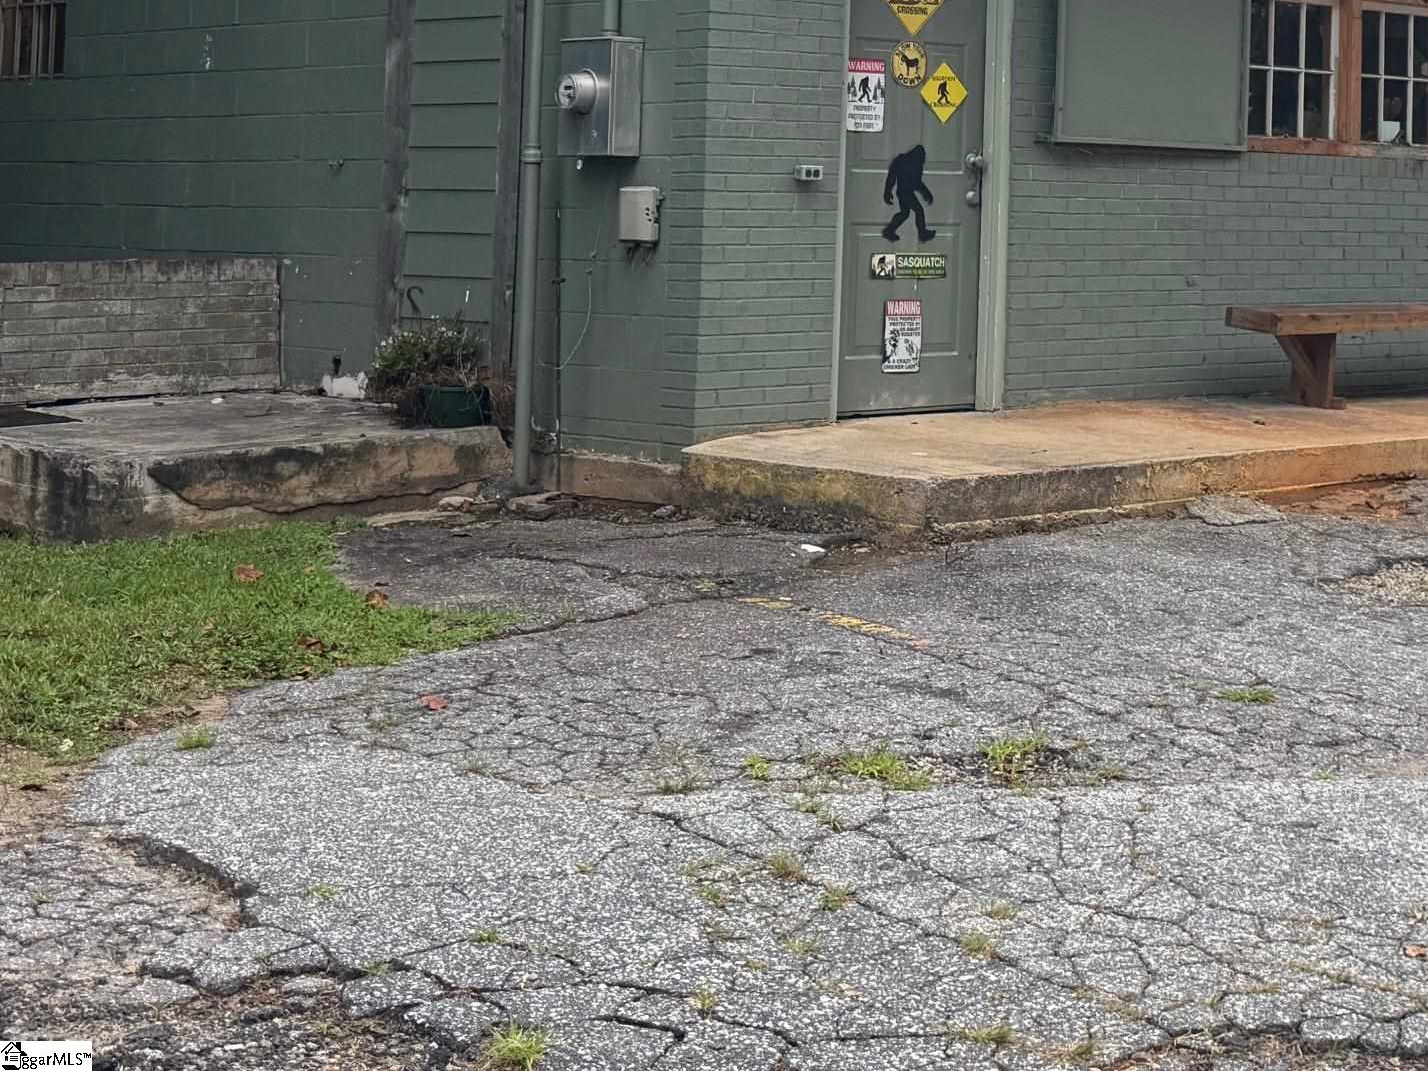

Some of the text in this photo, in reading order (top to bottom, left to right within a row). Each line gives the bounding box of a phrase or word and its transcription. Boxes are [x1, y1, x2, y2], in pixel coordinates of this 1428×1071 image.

[896, 5, 928, 16] CROSSING
[848, 60, 885, 71] WARNING
[898, 73, 921, 84] DOWN
[897, 256, 945, 267] SASQUATCH
[887, 300, 921, 315] WARNING
